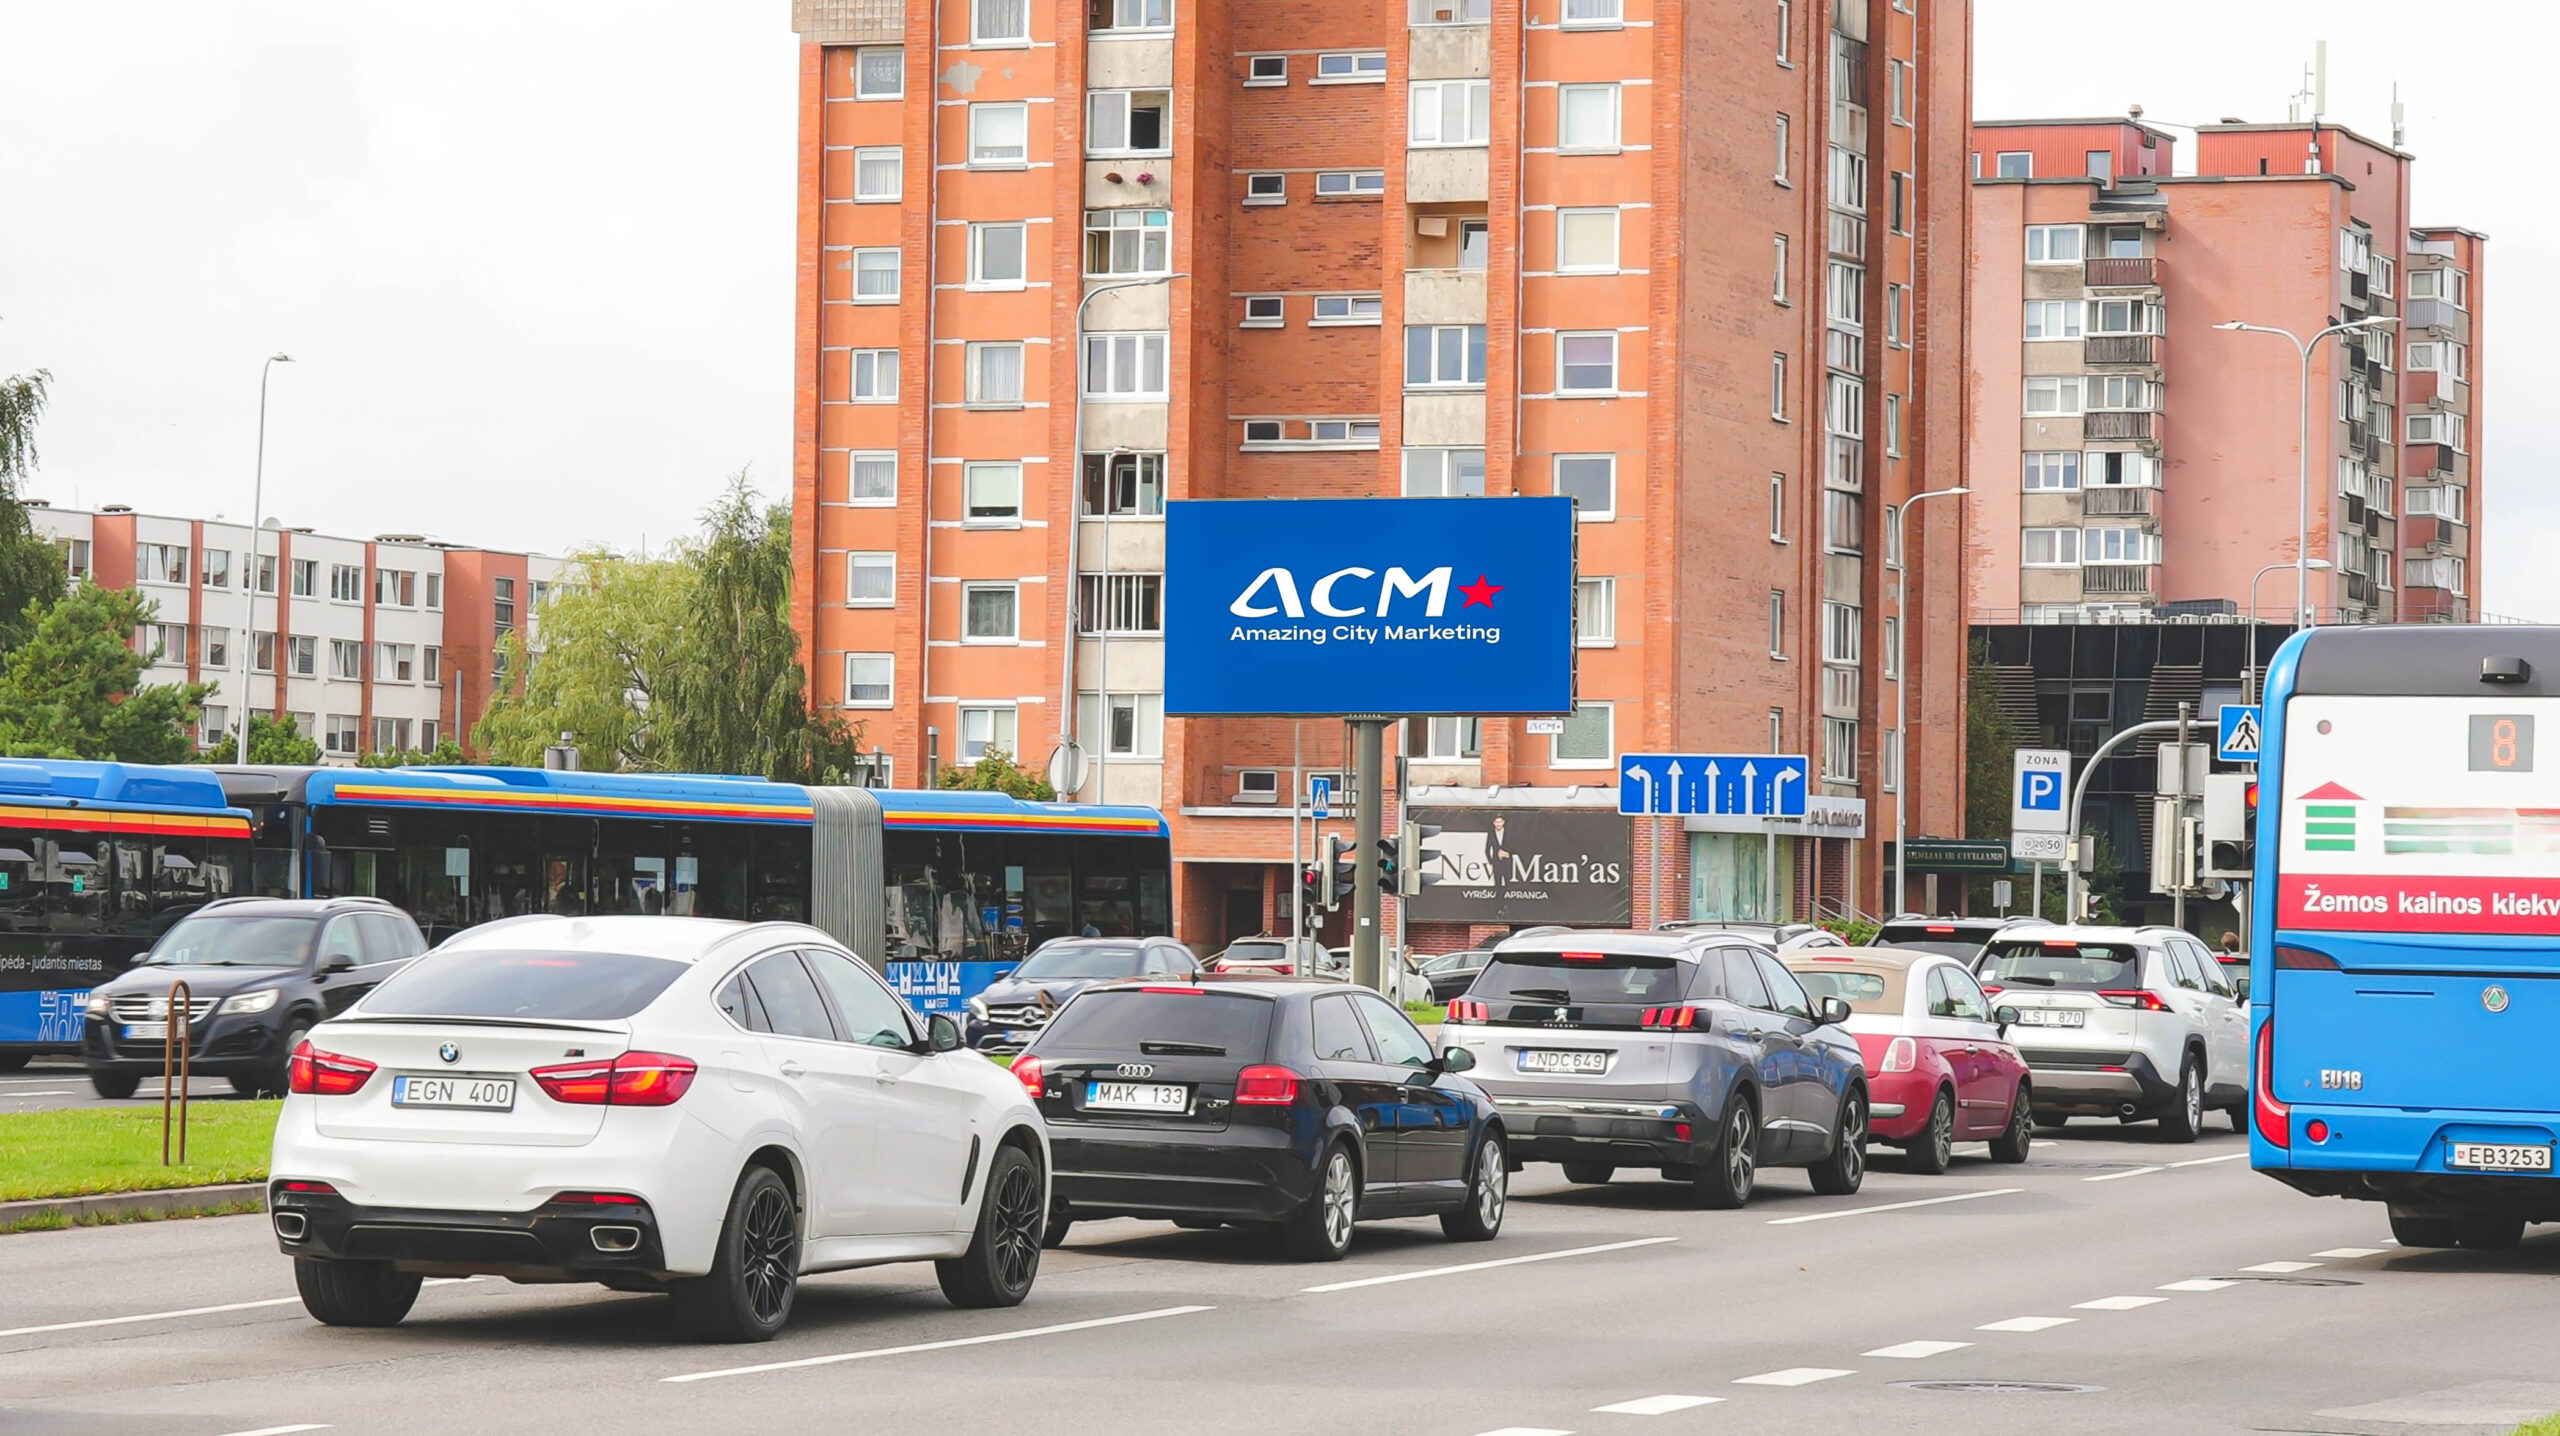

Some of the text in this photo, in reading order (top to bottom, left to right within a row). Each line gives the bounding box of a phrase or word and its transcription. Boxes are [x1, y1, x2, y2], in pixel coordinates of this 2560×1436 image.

[1230, 566, 1453, 618] ACM
[1230, 624, 1500, 645] Amazing City Marketing
[2493, 719, 2516, 767] 8
[2026, 755, 2059, 766] ZONA
[2029, 774, 2054, 808] P
[2034, 840, 2045, 849] 20
[2047, 839, 2061, 850] 50
[1504, 890, 1549, 900] APRANGA
[2303, 883, 2388, 913] Žemos
[2398, 890, 2482, 915] kainos
[31, 955, 67, 973] judantis
[68, 955, 102, 971] miestas
[2023, 1011, 2081, 1024] LSI 870
[2321, 1069, 2363, 1090] EU18
[407, 1080, 455, 1102] EGN
[468, 1082, 509, 1104] 400
[1099, 1084, 1138, 1102] MAK
[1153, 1086, 1184, 1104] 133
[2469, 1147, 2545, 1167] EB3253
